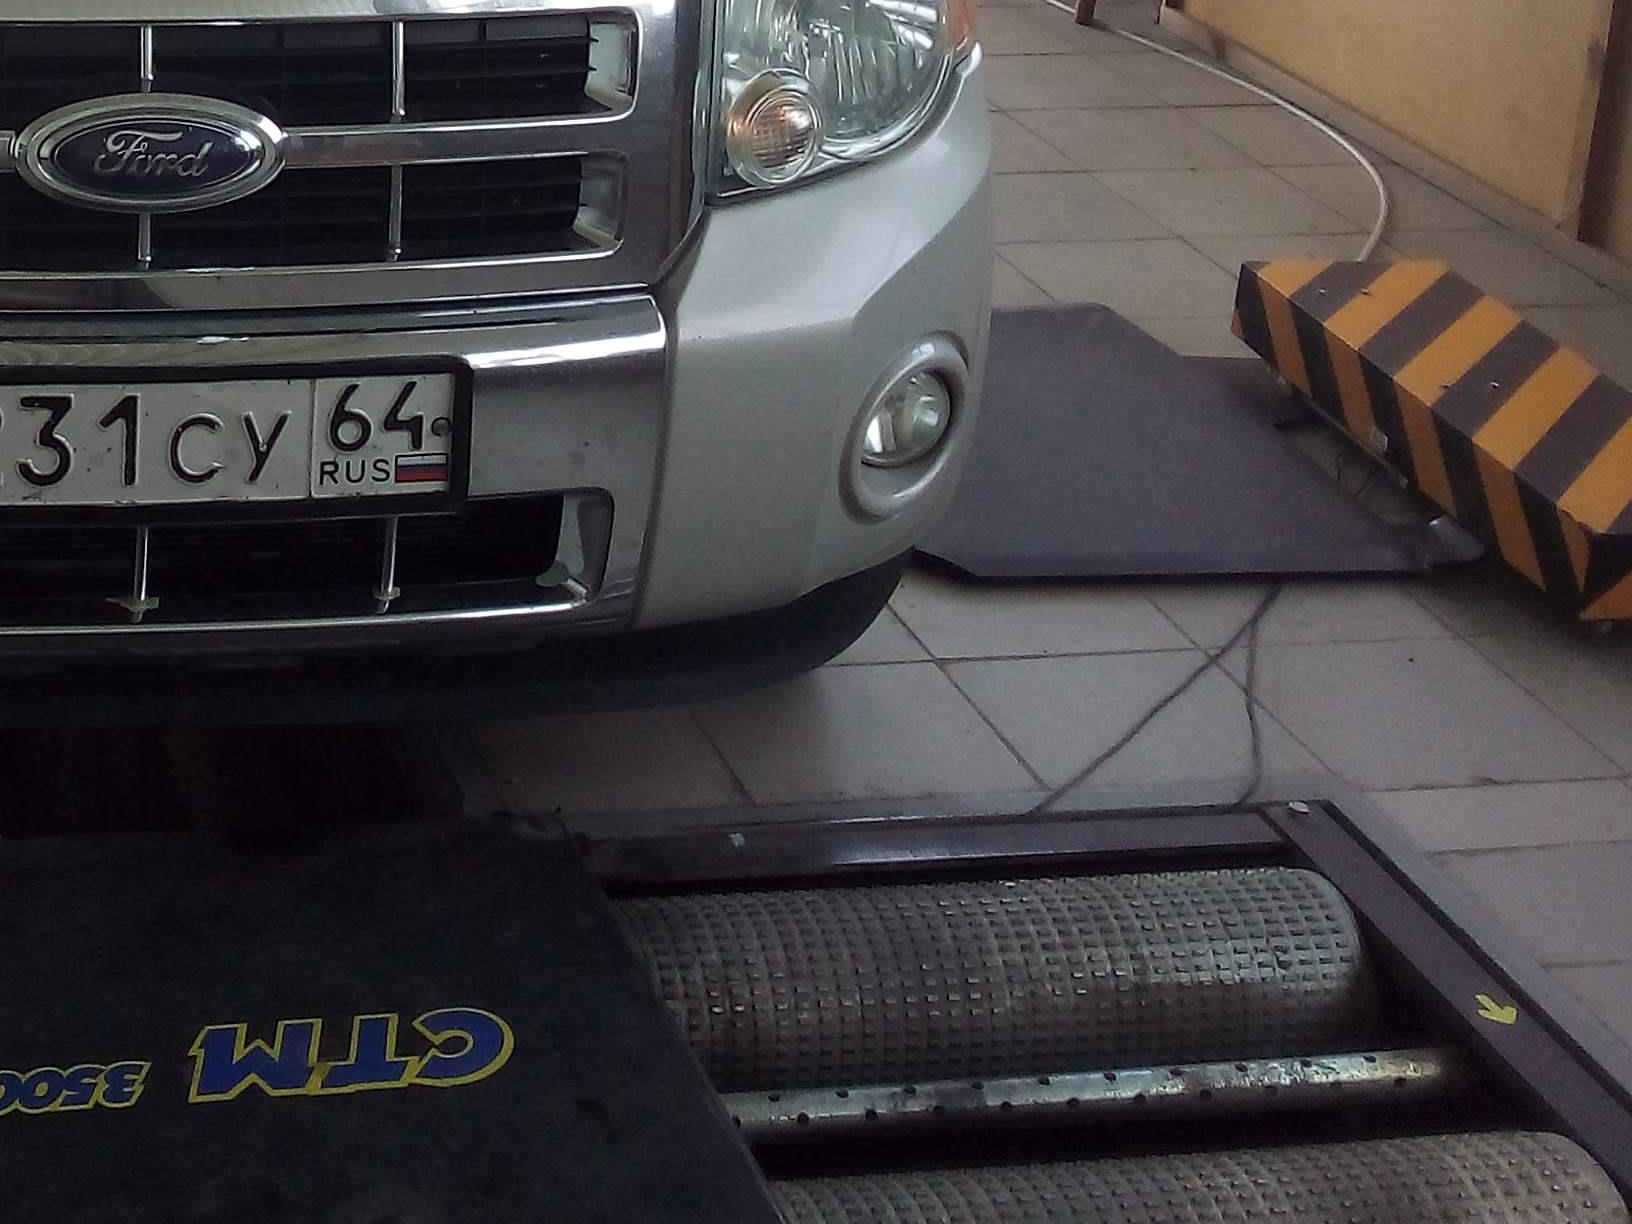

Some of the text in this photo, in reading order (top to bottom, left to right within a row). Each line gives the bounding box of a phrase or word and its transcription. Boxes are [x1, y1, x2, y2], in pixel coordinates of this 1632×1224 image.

[94, 129, 214, 177] Ford
[330, 380, 425, 453] 64
[319, 458, 391, 486] RUS
